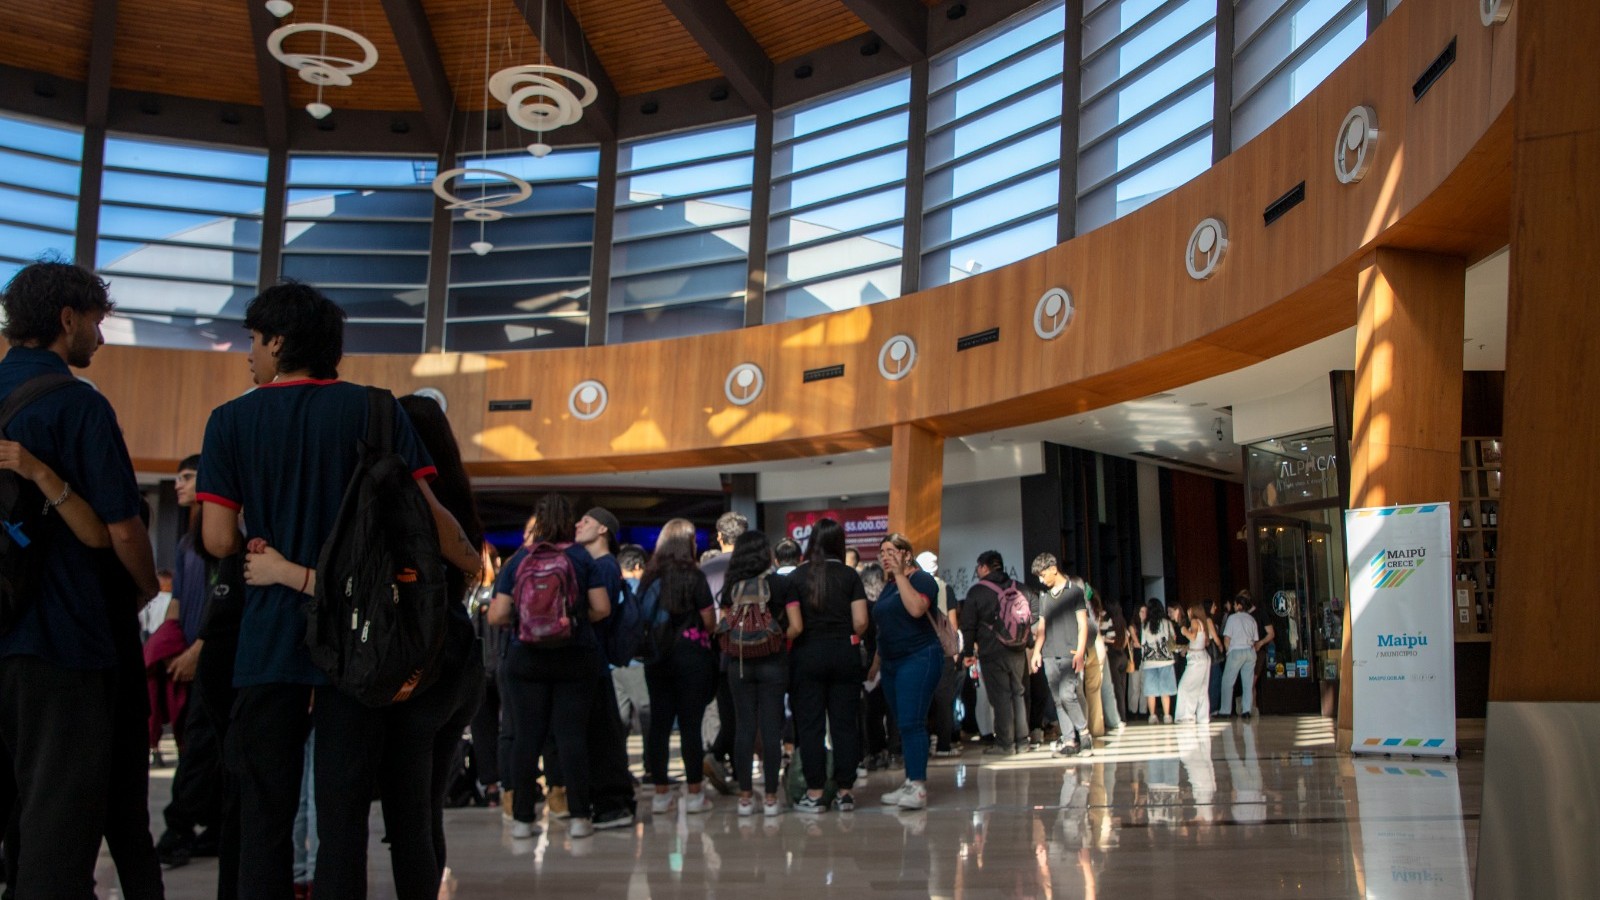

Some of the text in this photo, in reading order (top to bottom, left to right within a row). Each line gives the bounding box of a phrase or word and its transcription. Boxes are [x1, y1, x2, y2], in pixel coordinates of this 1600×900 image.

[1280, 453, 1336, 478] ALPACA
[845, 520, 888, 532] $5.000.00
[1387, 547, 1426, 559] MAIPÚ
[1387, 560, 1414, 568] CRECE
[1377, 631, 1428, 649] Maipú
[1380, 650, 1418, 658] MUNICIPIO
